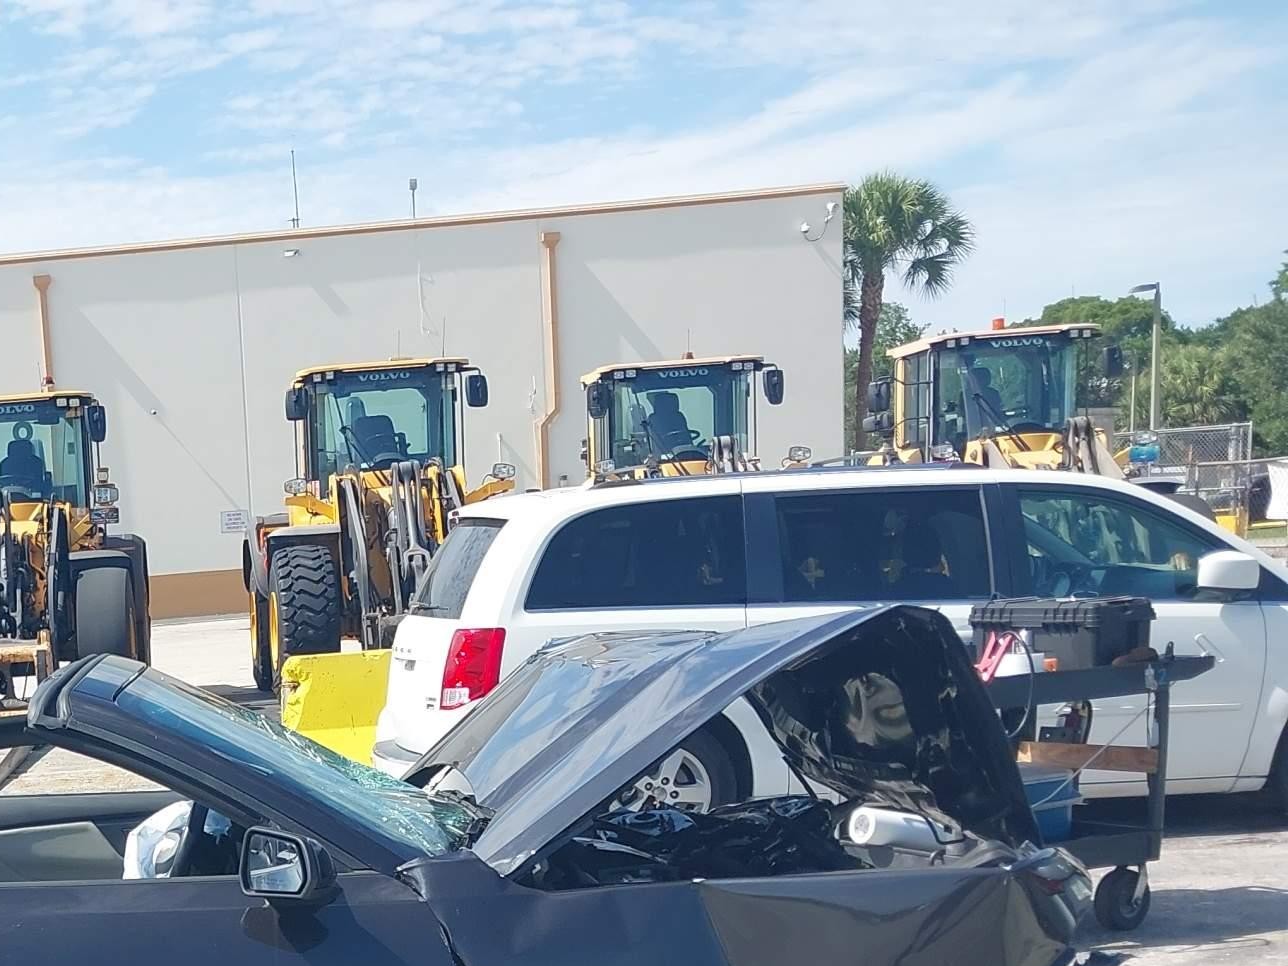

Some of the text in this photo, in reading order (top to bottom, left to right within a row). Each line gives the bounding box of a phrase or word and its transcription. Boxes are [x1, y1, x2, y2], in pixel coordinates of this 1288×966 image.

[990, 338, 1043, 349] VOLVO
[358, 371, 410, 382] VOLVO
[658, 368, 709, 378] VOLVO
